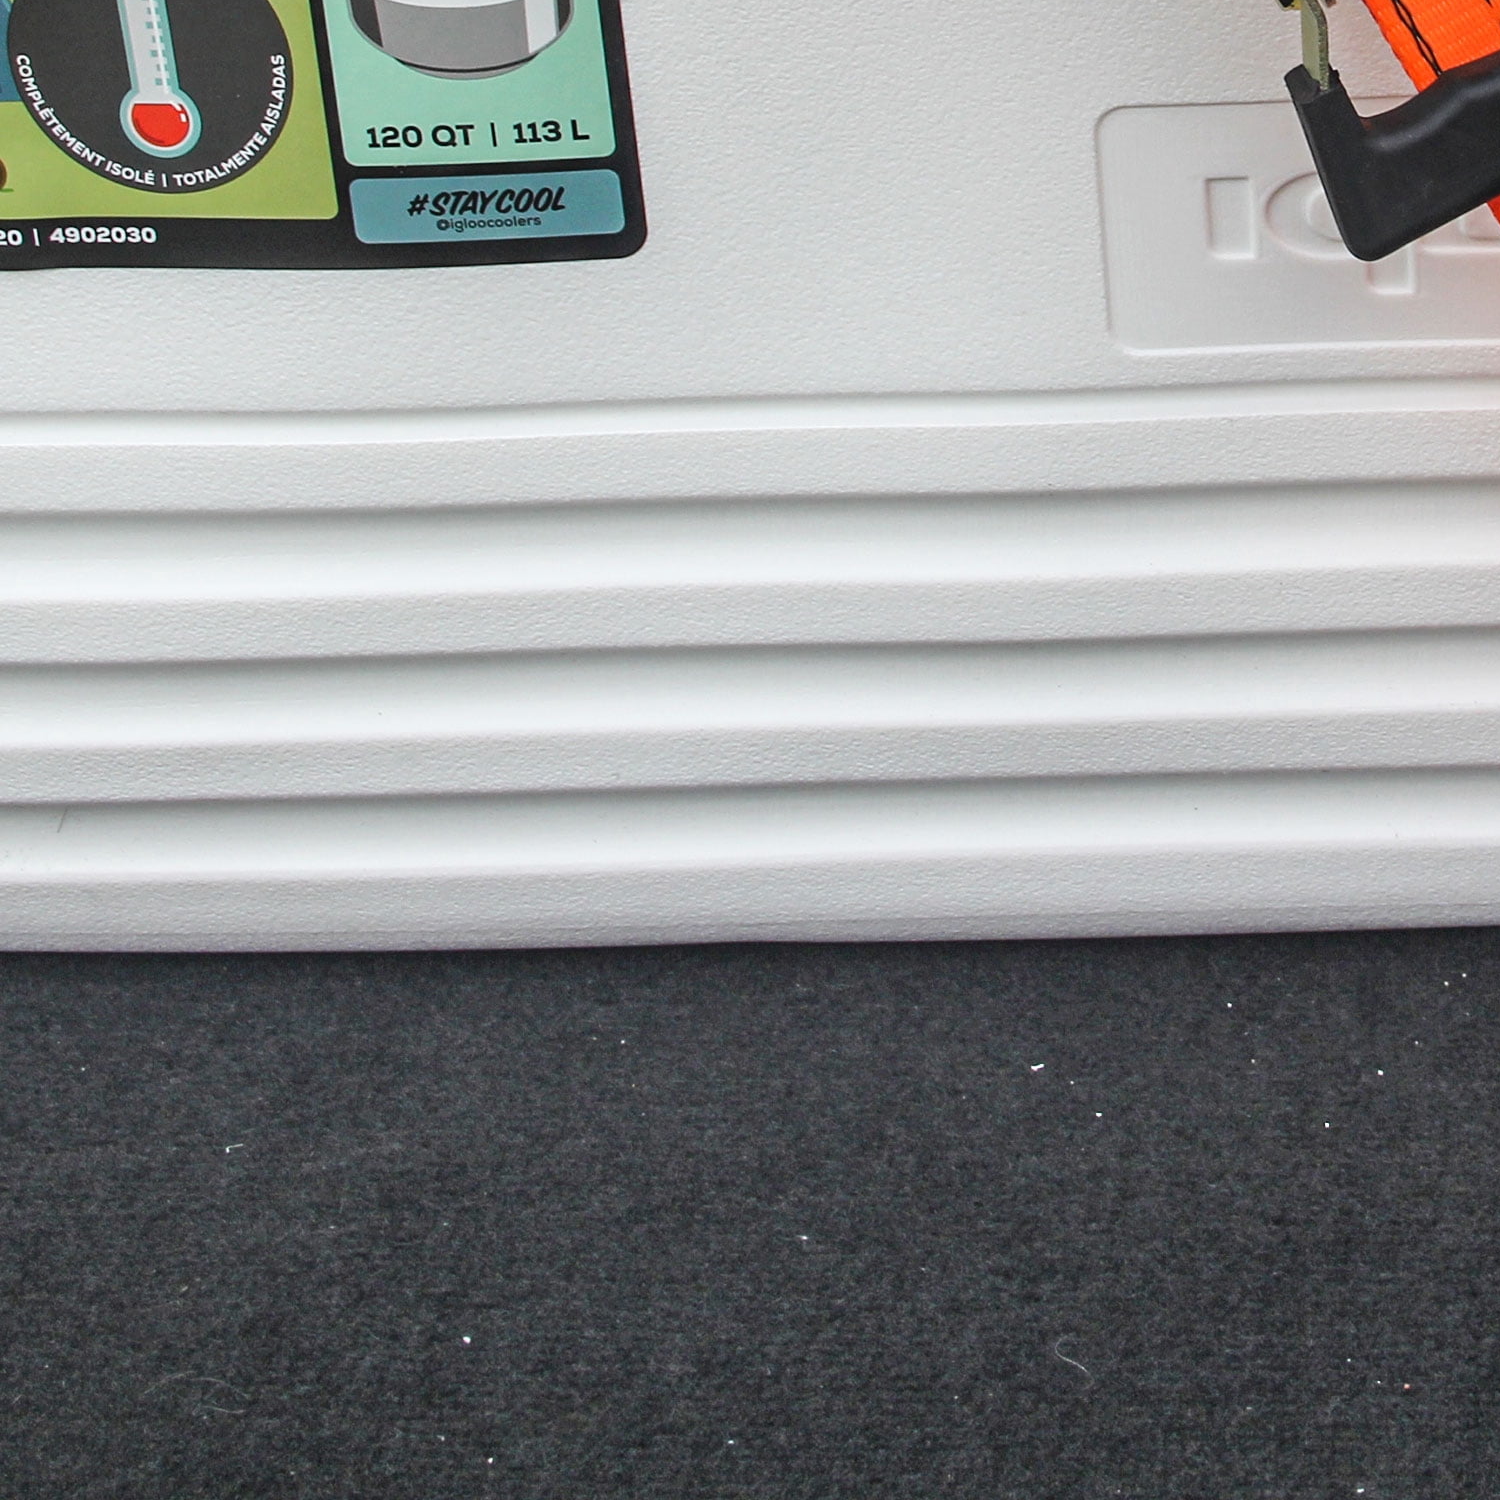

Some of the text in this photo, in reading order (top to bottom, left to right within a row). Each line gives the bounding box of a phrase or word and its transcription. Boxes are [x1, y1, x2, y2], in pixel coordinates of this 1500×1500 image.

[16, 54, 287, 187] COMPLÈTEMENT ISOLÉ TOTALMENTE AISLADAS
[366, 119, 591, 148] 120 QT 113 L
[407, 186, 566, 216] #STAYCOOL
[50, 227, 157, 244] 4902030
[436, 214, 542, 233] @igloocoolers
